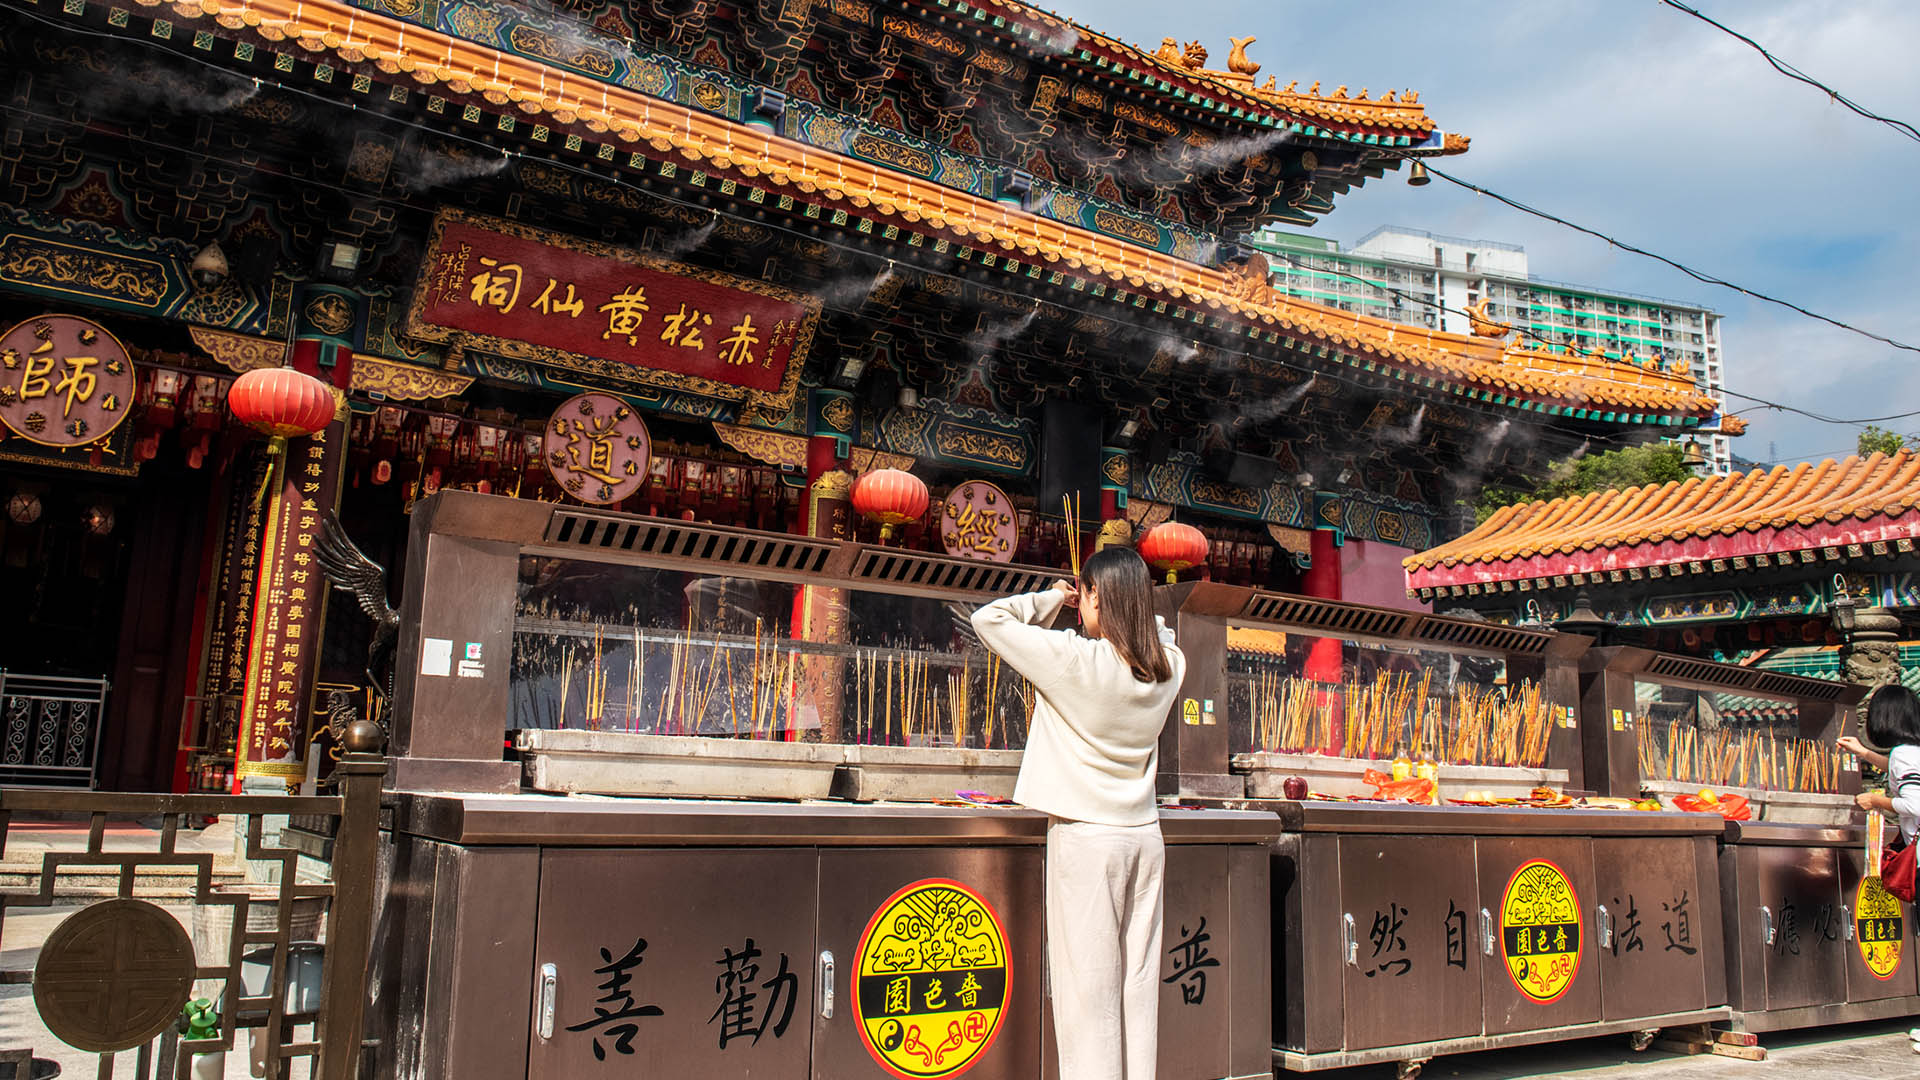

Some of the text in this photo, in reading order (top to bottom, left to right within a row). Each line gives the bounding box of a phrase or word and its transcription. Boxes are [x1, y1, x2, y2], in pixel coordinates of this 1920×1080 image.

[470, 256, 759, 367] 赤松黃仙祠
[19, 339, 100, 420] 師
[566, 415, 626, 486] 道
[956, 502, 998, 555] 經
[883, 972, 983, 1014] 嗇色園
[1162, 916, 1221, 1006] 普
